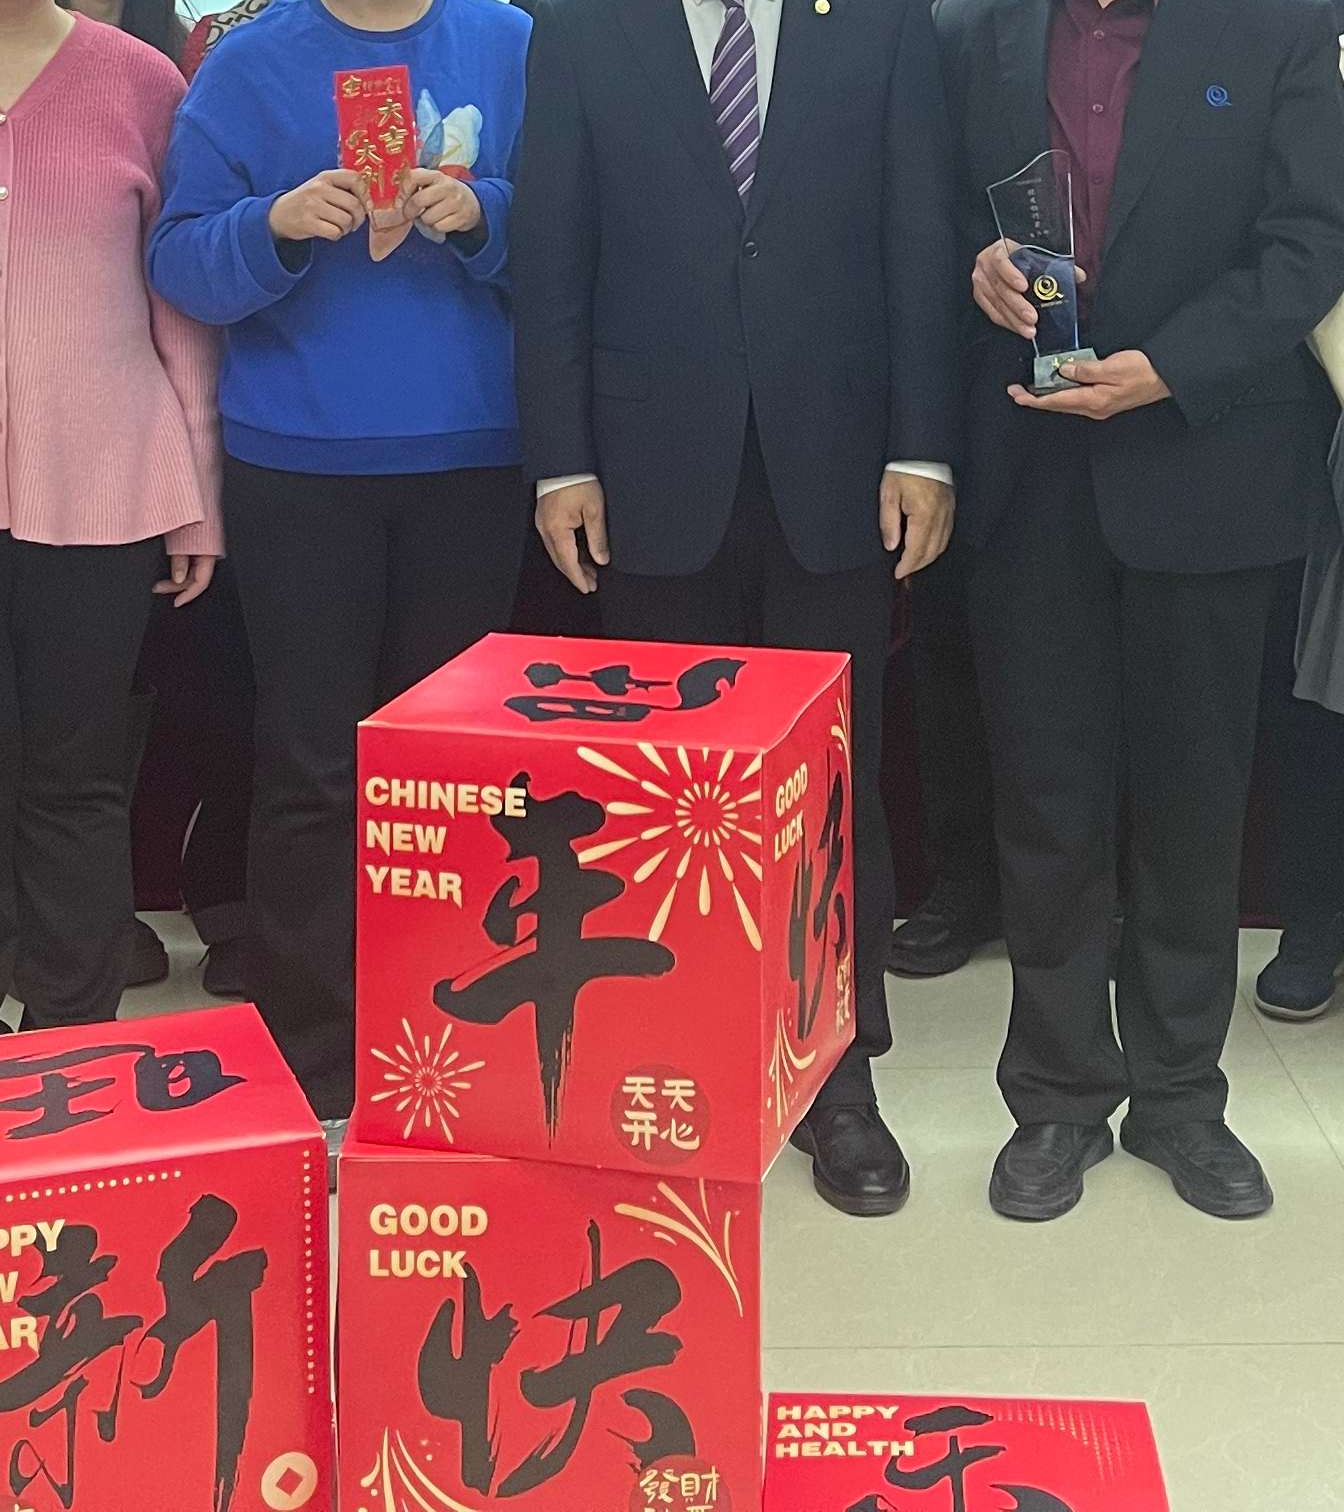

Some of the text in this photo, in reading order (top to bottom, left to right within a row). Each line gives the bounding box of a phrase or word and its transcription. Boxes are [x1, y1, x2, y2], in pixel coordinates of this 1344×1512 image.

[377, 98, 408, 155] 大吉
[365, 776, 527, 819] CHINESE
[775, 762, 808, 818] GOOD
[366, 821, 446, 856] NEW
[774, 810, 804, 863] LUCK
[365, 865, 463, 909] YEAR
[432, 771, 676, 1150] 年
[622, 1076, 696, 1113] 天天
[369, 1204, 488, 1237] GOOD
[369, 1250, 468, 1278] LUCK
[417, 1218, 696, 1499] 快
[776, 1405, 899, 1420] HAPPY
[776, 1422, 857, 1440] AND
[775, 1440, 915, 1458] HEALTH
